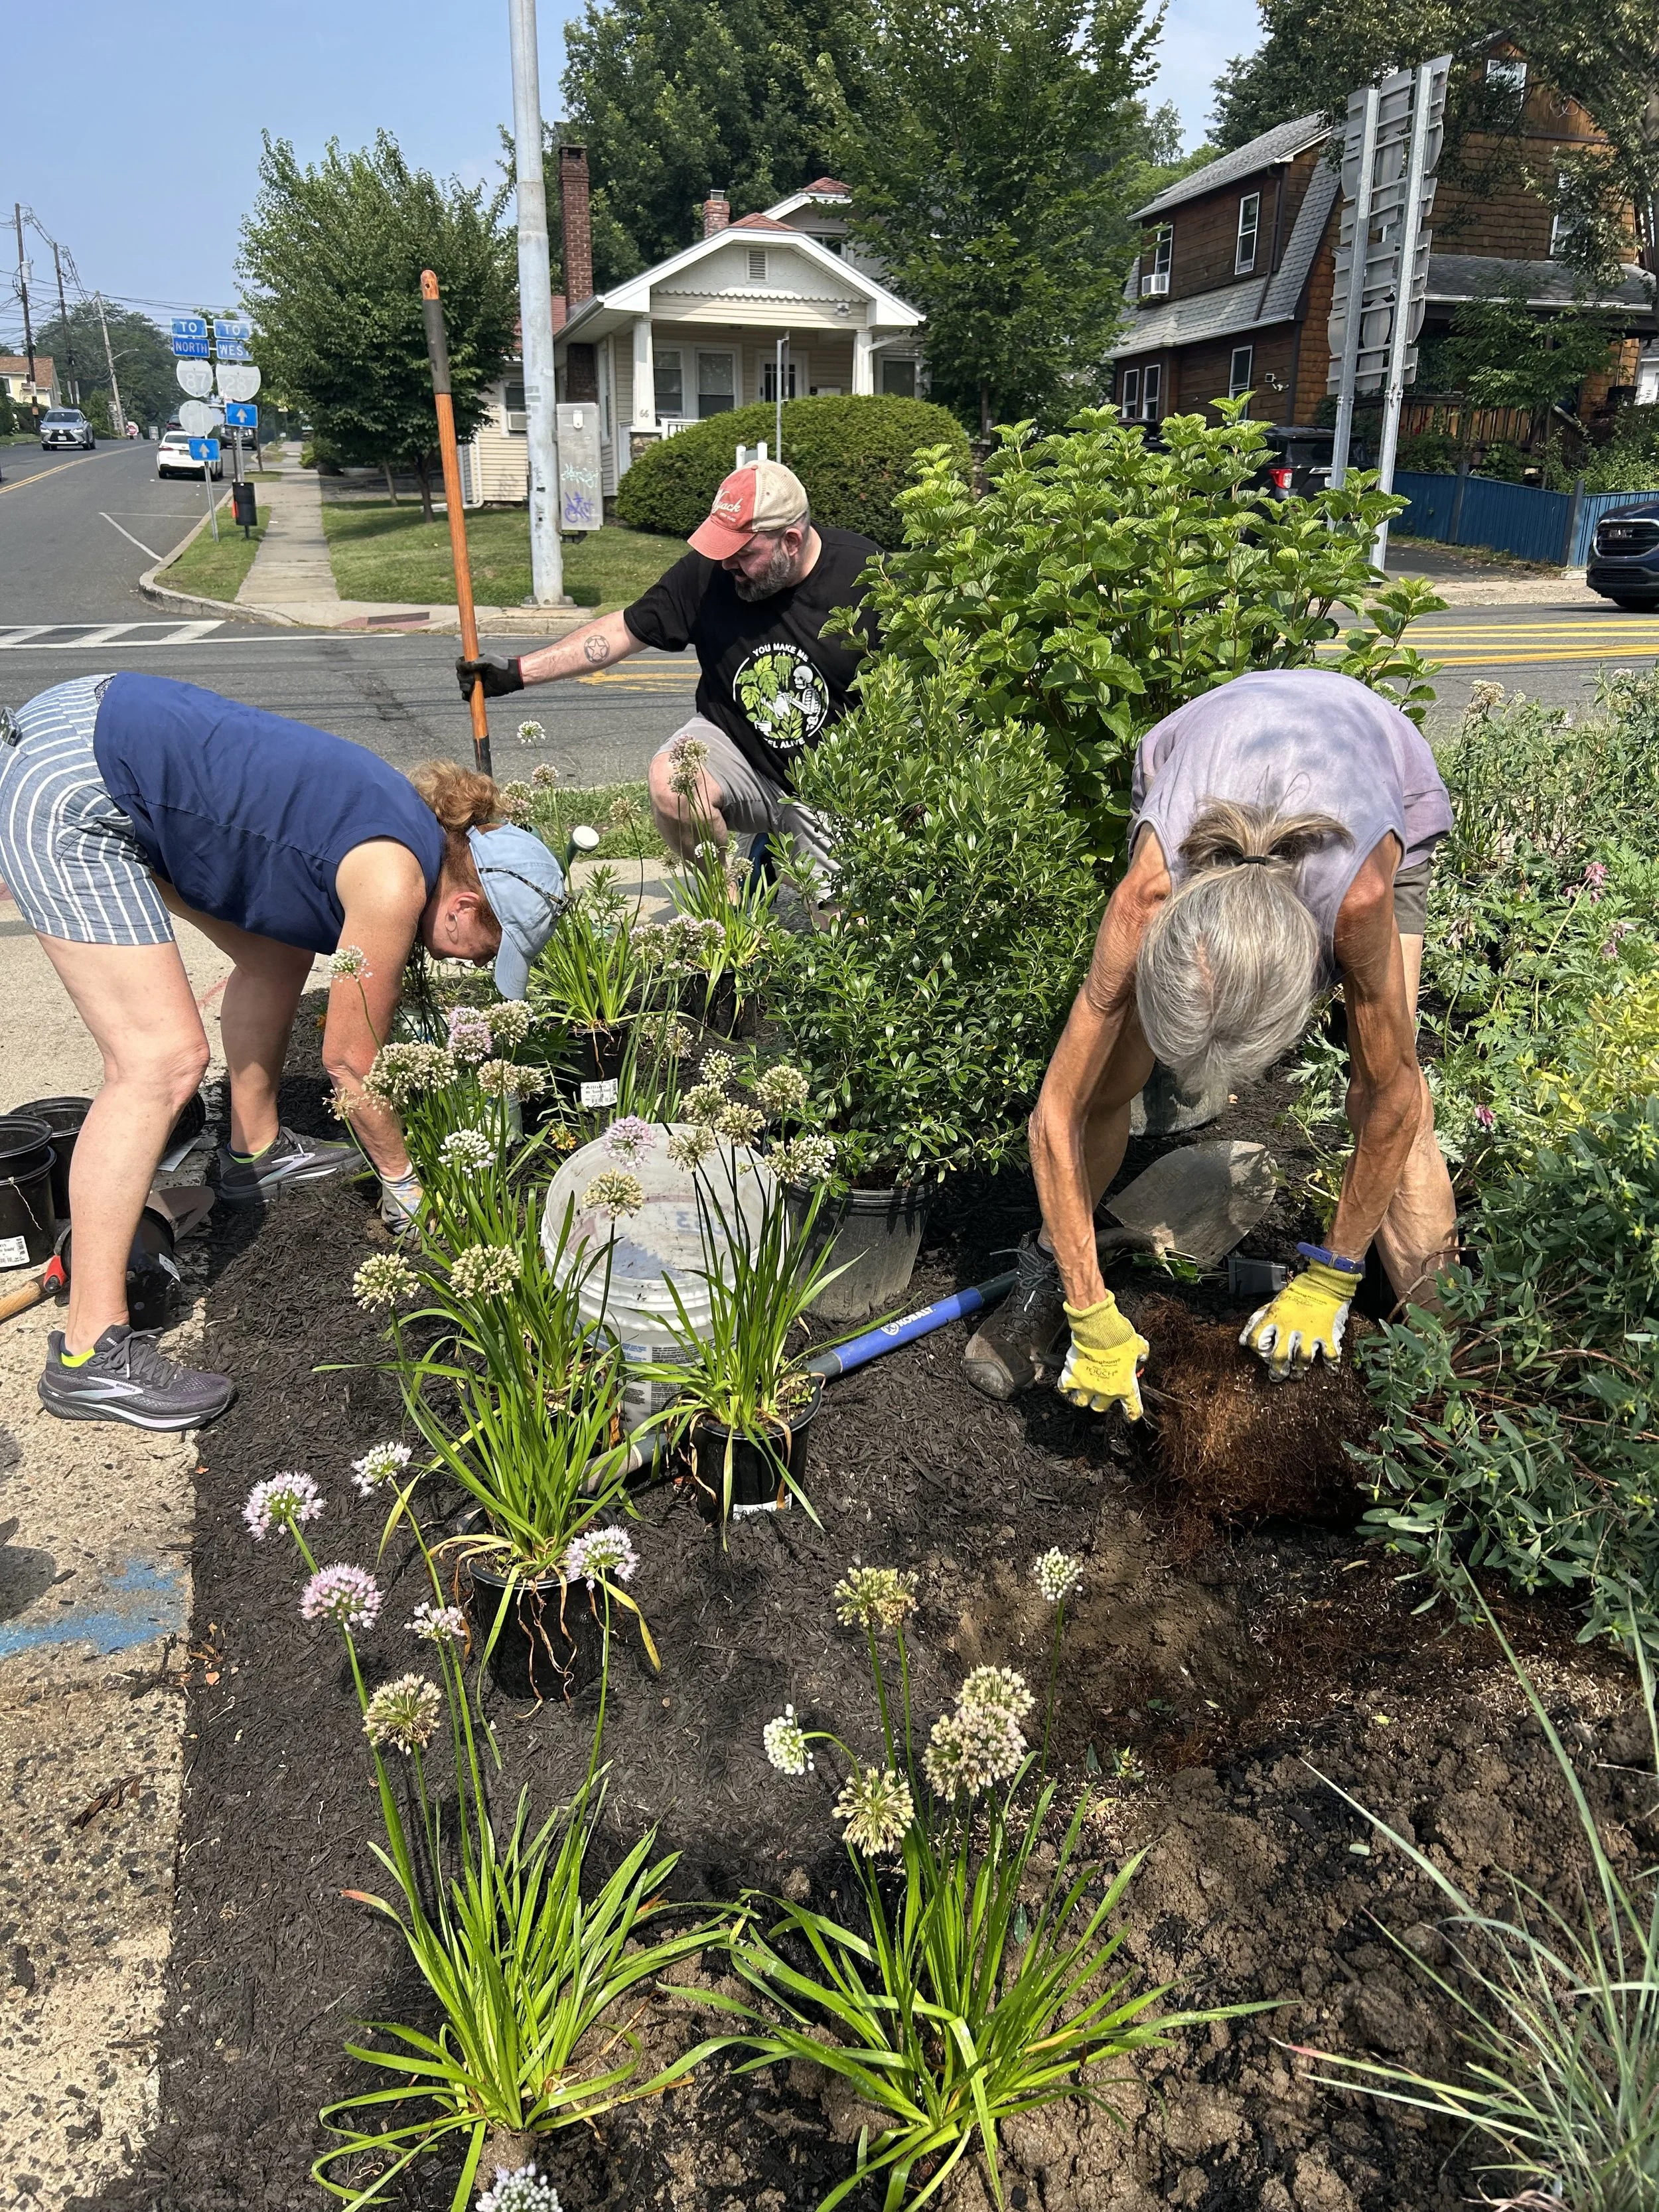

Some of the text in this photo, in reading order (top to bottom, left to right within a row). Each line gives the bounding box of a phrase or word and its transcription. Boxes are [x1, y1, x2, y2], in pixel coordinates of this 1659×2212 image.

[179, 321, 198, 333] TO
[223, 324, 241, 335] TO
[175, 339, 208, 354] NORTH
[185, 372, 207, 390] 87
[224, 375, 257, 393] 287
[639, 409, 650, 418] 66
[1609, 529, 1633, 539] GMC
[752, 643, 809, 662] YOU MAKE ME
[780, 737, 806, 749] ALIVE
[896, 1306, 934, 1327] KOBALT
